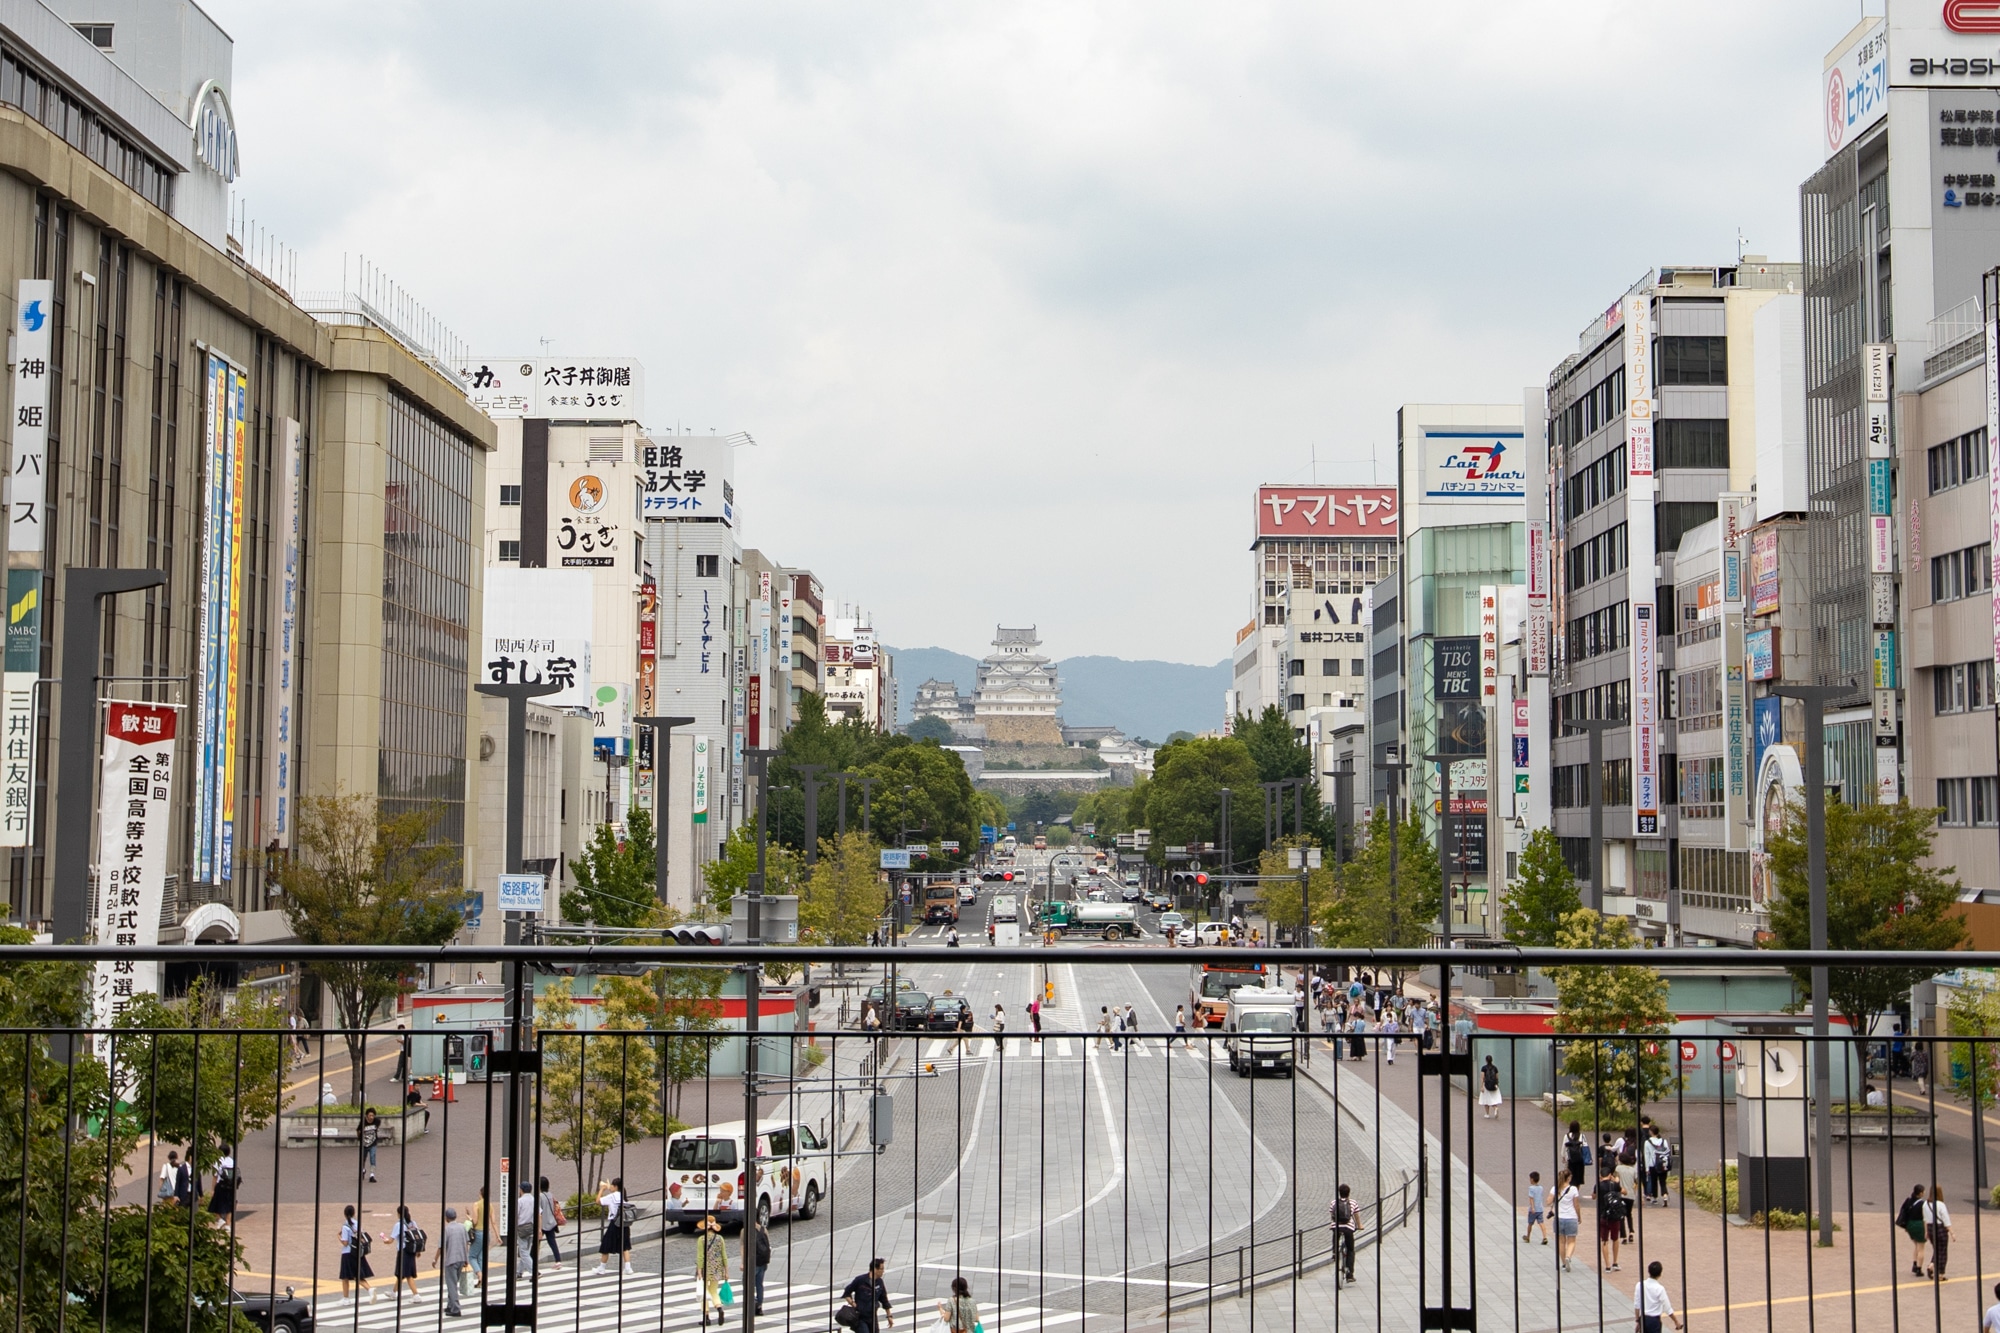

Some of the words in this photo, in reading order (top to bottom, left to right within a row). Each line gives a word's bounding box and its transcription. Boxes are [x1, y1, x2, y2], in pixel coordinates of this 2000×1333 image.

[1944, 174, 1995, 188] 中学受験
[521, 366, 531, 375] 6F
[544, 367, 631, 387] 穴子丼御膳
[14, 357, 45, 524] 神姫バス
[1441, 482, 1475, 491] パチンコ
[556, 517, 619, 553] うさぎ
[1727, 556, 1738, 598] ADERANS
[8, 626, 37, 636] SMBC
[781, 614, 789, 663] 第一生命
[1441, 652, 1471, 667] TBC
[1483, 596, 1495, 696] 播州信用金庫
[487, 656, 577, 689] すし宗
[1443, 679, 1471, 693] TBC
[122, 714, 161, 735] 歓迎
[1729, 695, 1743, 796] 三井住友信託銀行
[5, 690, 31, 831] 三井住友銀行
[152, 752, 169, 801] 第64回
[697, 766, 705, 806] りそな銀行
[500, 896, 516, 905] Himeji
[502, 881, 540, 896] 姫路駅北
